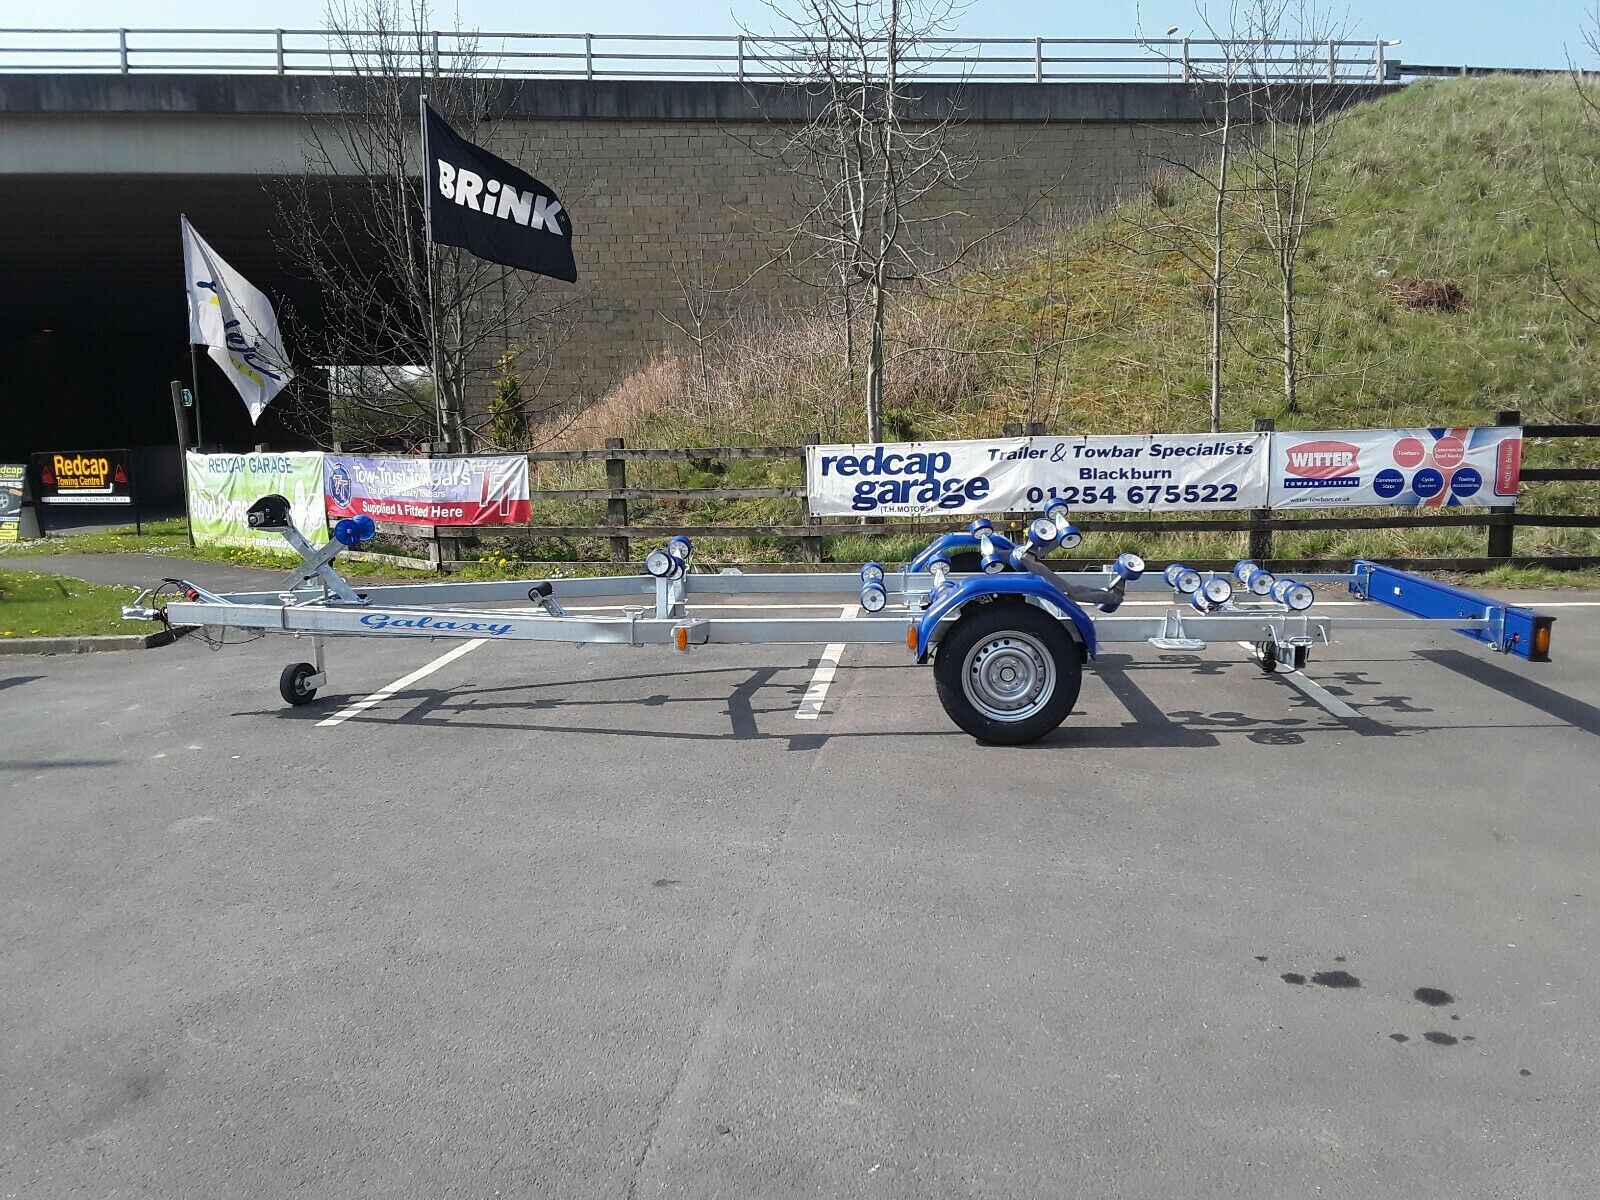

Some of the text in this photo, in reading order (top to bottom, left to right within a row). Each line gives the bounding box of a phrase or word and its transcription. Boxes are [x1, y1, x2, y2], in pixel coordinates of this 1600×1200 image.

[988, 442, 1254, 463] Trailer & Towbar Specialists
[1291, 451, 1354, 467] WITTER
[0, 466, 23, 478] dcap
[53, 454, 109, 485] Redcap
[208, 457, 294, 473] REDCAP GARAGE
[821, 447, 952, 481] redcap
[57, 476, 101, 488] Towing Centre
[1079, 467, 1172, 480] Blackburn
[852, 476, 990, 511] garage
[1026, 484, 1238, 504] 01254 675522
[362, 501, 396, 516] Supplied
[403, 504, 429, 517] Fitted
[430, 505, 463, 518] Here
[360, 614, 516, 635] Galaxy
